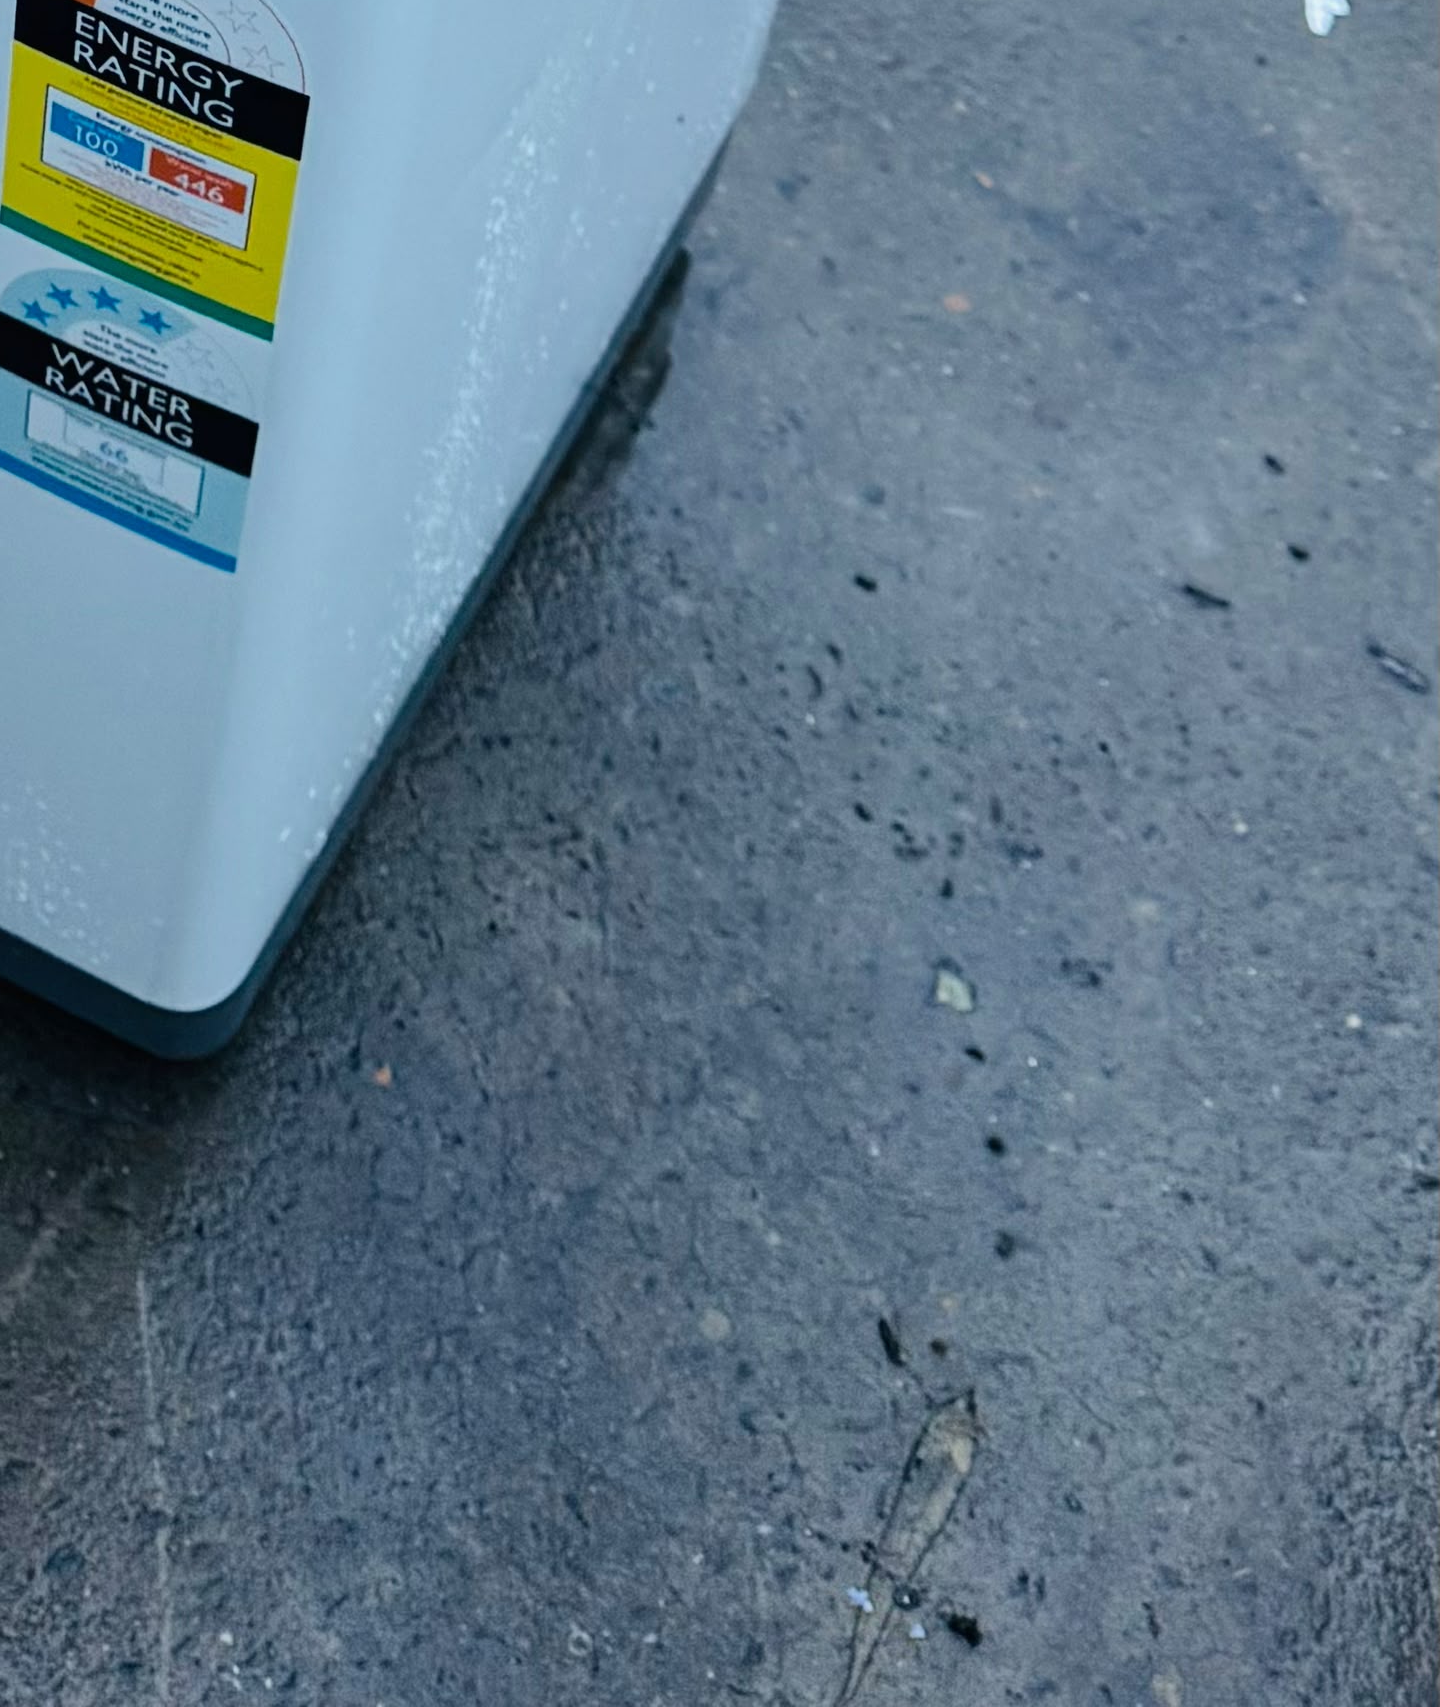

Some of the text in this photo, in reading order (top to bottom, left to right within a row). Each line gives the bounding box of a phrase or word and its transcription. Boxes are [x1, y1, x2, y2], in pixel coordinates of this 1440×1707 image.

[152, 8, 172, 23] the
[176, 21, 211, 39] more
[164, 2, 199, 21] more
[114, 6, 210, 51] energy efficient
[75, 10, 244, 99] ENERGY
[73, 39, 235, 128] RATING
[96, 111, 133, 134] Energy
[74, 125, 119, 158] 100
[174, 173, 224, 205] 446
[51, 342, 193, 424] WATER
[45, 366, 193, 448] RATING
[99, 441, 129, 465] 66
